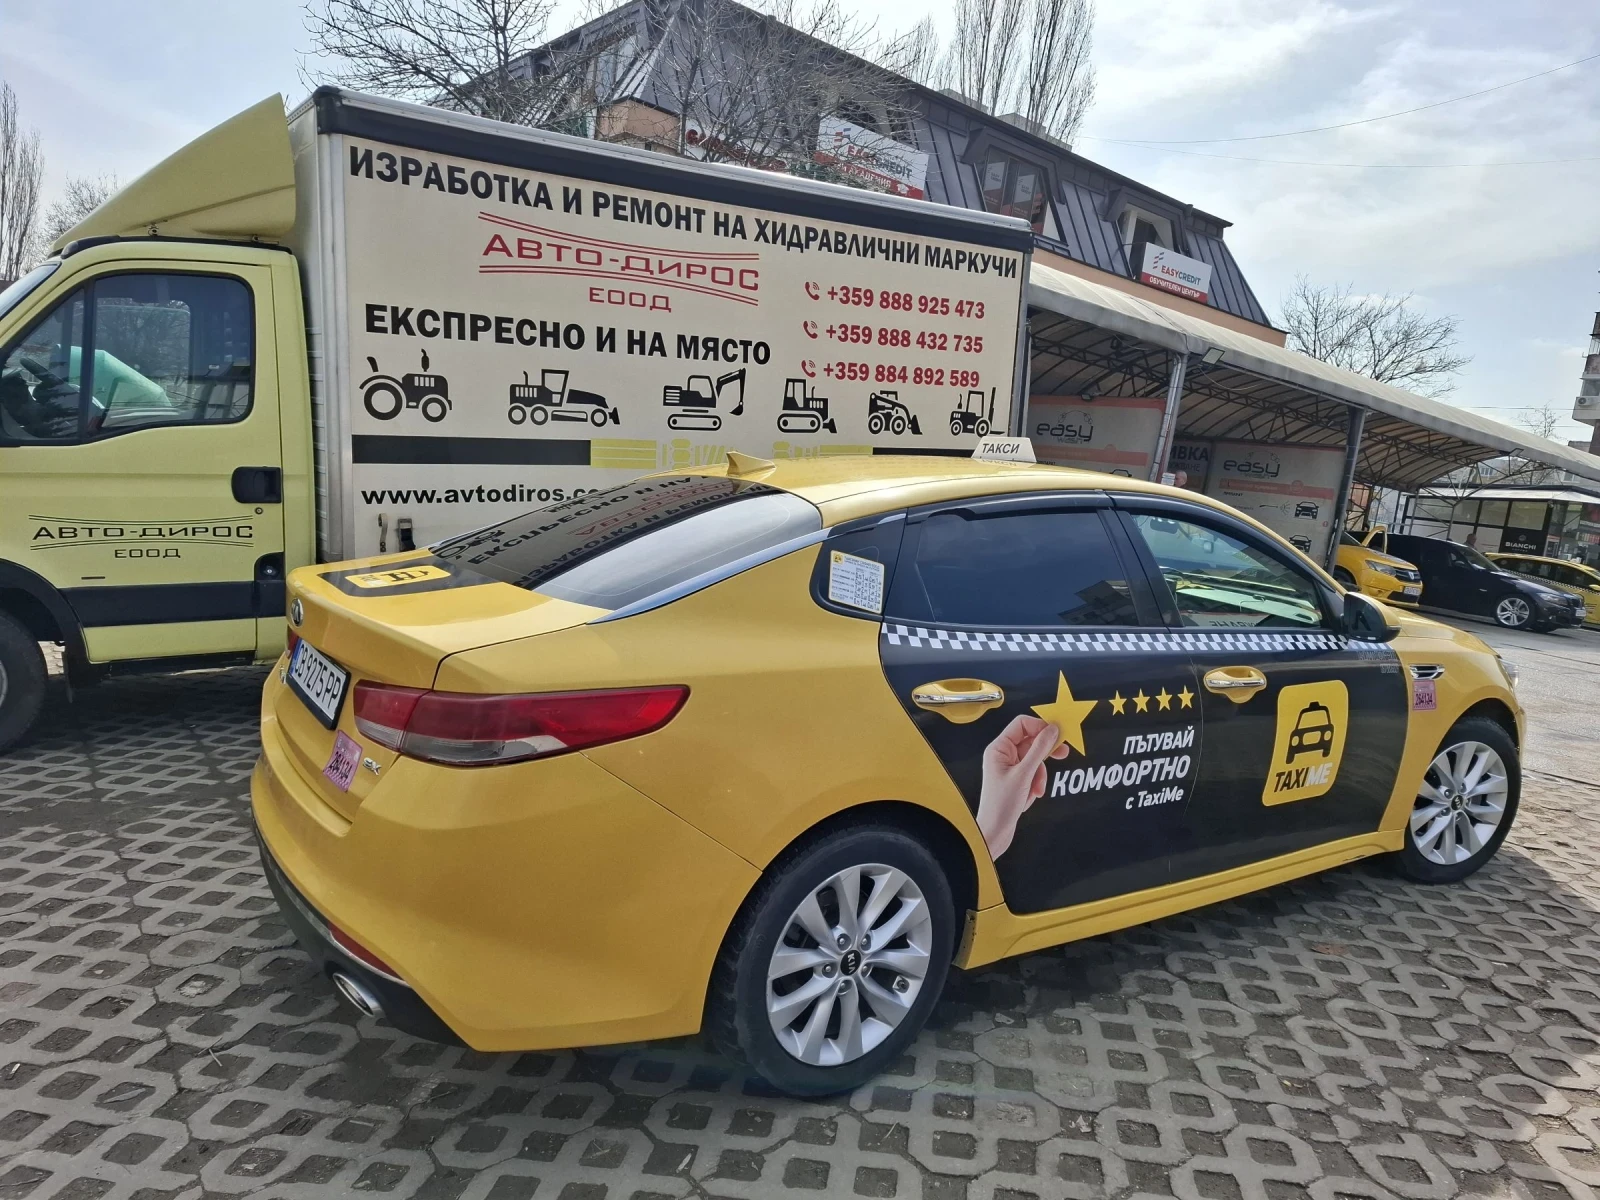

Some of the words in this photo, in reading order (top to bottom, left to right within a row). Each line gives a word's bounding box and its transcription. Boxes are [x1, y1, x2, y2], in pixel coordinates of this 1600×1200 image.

[350, 145, 554, 211] ИЗРАБОТКА
[562, 186, 582, 215] И
[592, 191, 705, 234] РЕМОНТ
[714, 211, 748, 241] НА
[754, 217, 920, 266] ХИДРАВЛИЧНИ
[925, 246, 1018, 279] МАРКУЧИ
[482, 233, 760, 292] АВТО-ДИРОС
[1161, 265, 1202, 286] EASYCREDIT
[1149, 276, 1181, 292] ОБУЧИТЕЛЕН
[1181, 287, 1200, 298] ЦЕНТЪР
[589, 287, 672, 313] ЕООД
[827, 285, 874, 308] +359
[879, 291, 913, 312] 888
[918, 296, 950, 316] 925
[955, 300, 985, 319] 473
[365, 303, 586, 351] ЕКСПРЕСНО
[596, 327, 616, 353] И
[627, 329, 668, 357] НА
[677, 334, 771, 366] МЯСТО
[825, 324, 873, 346] +359
[877, 328, 911, 349] 888
[916, 332, 948, 351] 432
[953, 335, 984, 354] 735
[823, 361, 870, 382] +359
[875, 365, 909, 384] 884
[913, 368, 945, 387] 892
[949, 370, 980, 388] 589
[1036, 423, 1094, 441] easy
[982, 443, 1020, 454] ТАКСИ
[1169, 445, 1209, 462] ИВКА
[1223, 459, 1281, 478] easy
[33, 525, 253, 540] АВТО-ДИРОС
[114, 548, 181, 558] ЕООД
[1505, 541, 1537, 550] BIANCHI
[1123, 725, 1195, 755] ПЪТУВАЙ
[1051, 755, 1191, 798] КОМФОРТНО
[1273, 762, 1333, 793] TAXIME
[1137, 786, 1184, 808] TaxiMe
[847, 953, 856, 974] KIA
